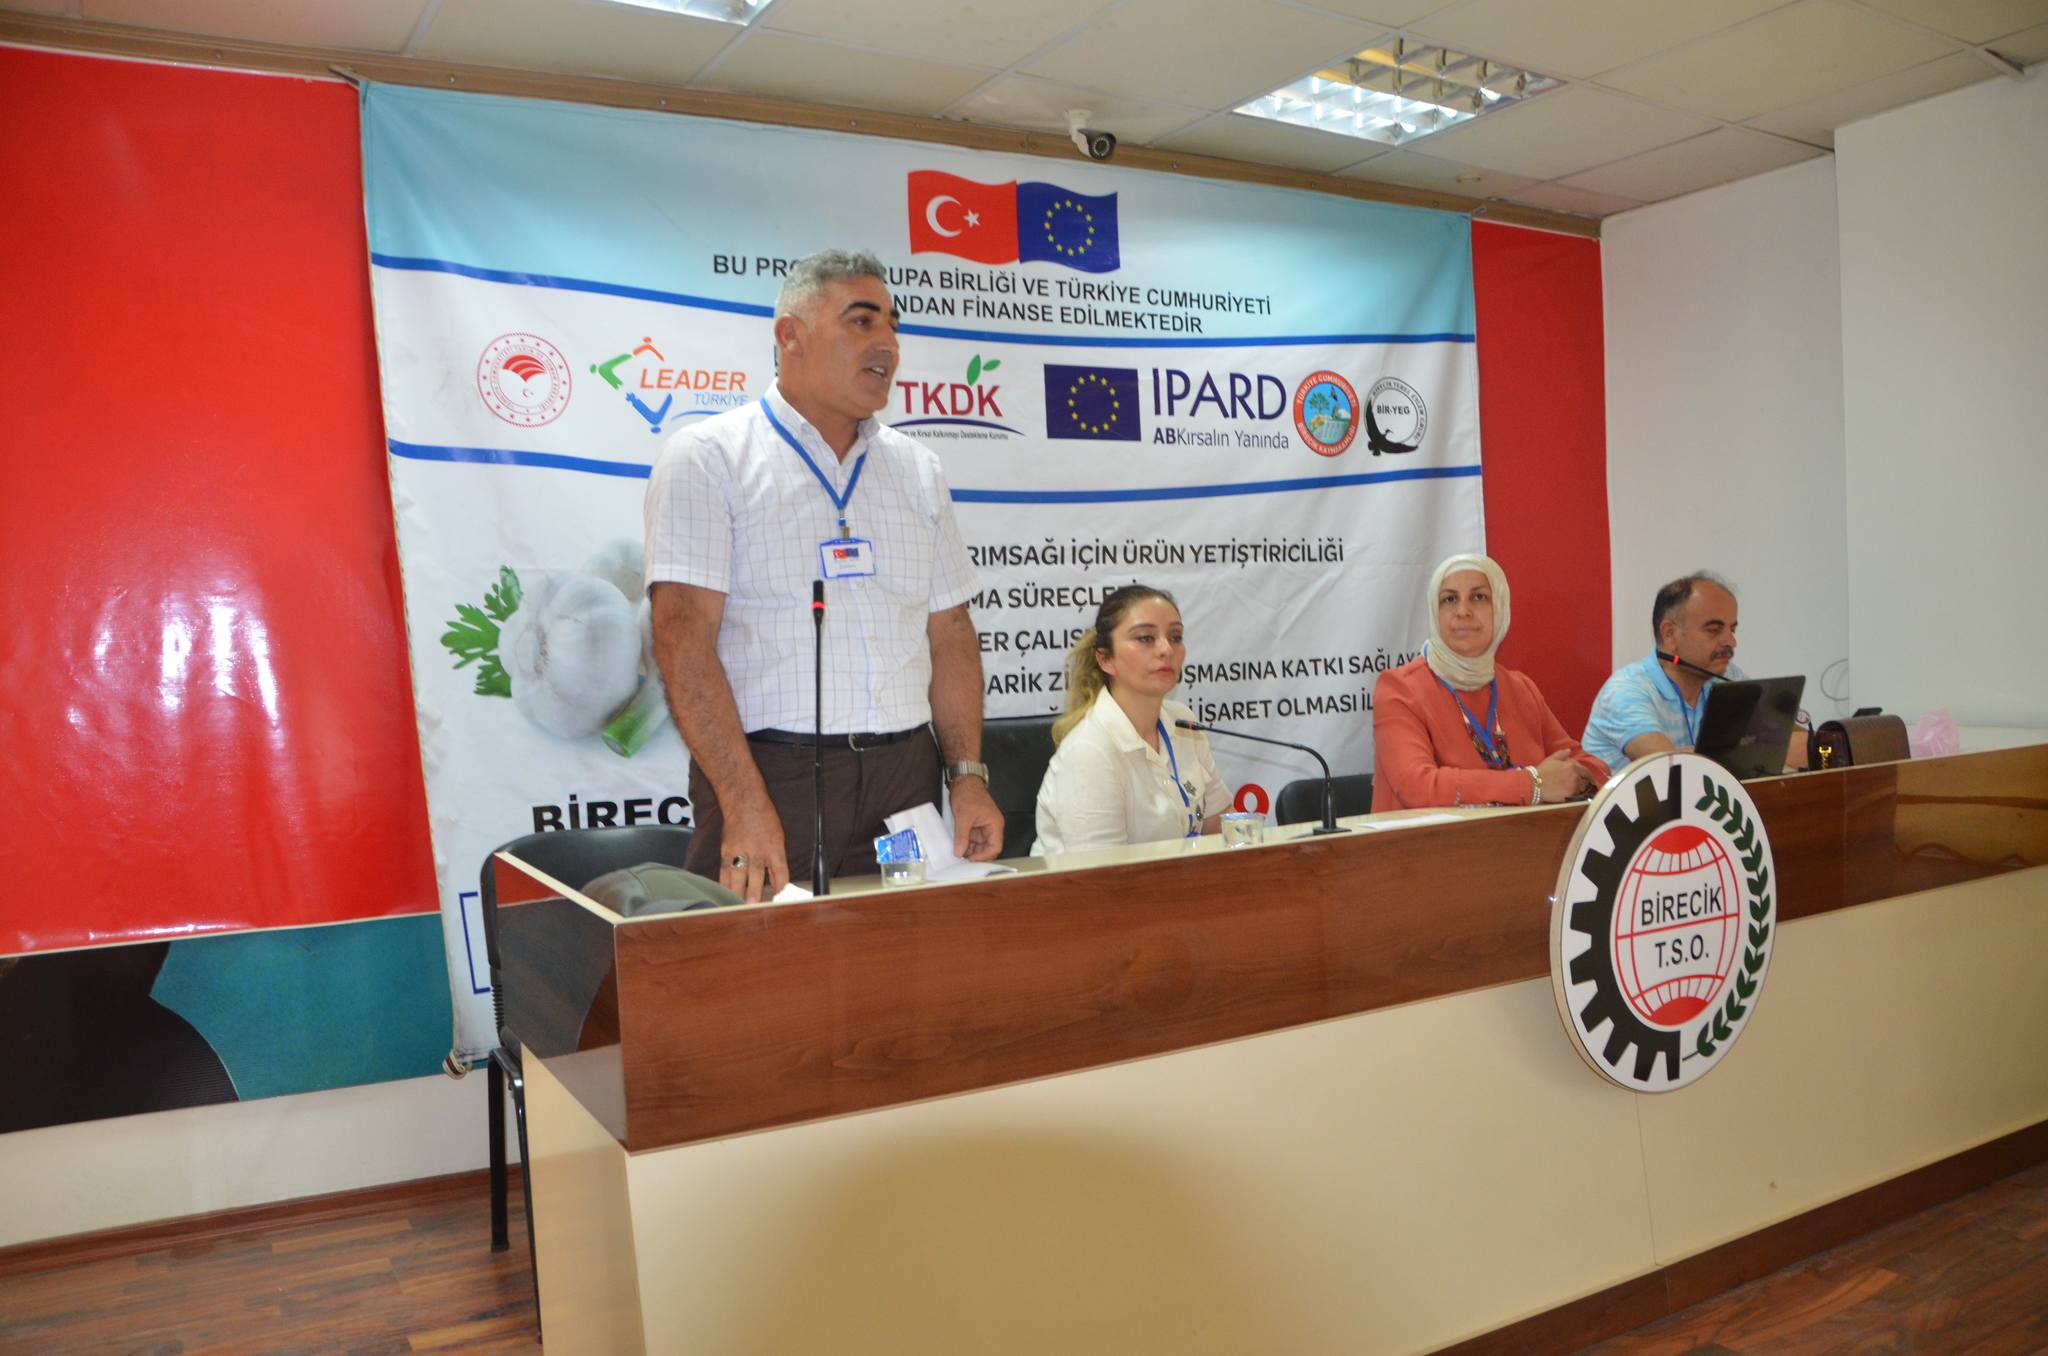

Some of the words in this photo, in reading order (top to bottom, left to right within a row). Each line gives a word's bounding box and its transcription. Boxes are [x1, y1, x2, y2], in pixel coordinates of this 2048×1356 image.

[713, 254, 747, 275] BU
[939, 268, 1016, 294] BİRLİĞİ
[1022, 278, 1049, 296] VE
[1055, 278, 1141, 304] TÜRKİYE
[1147, 288, 1272, 316] CUMHURİYETİ
[963, 296, 1053, 323] FİNANSE
[1060, 304, 1203, 334] EDİLMEKTEDİR
[640, 368, 747, 392] LEADER
[1152, 367, 1287, 421] IPARD
[694, 391, 749, 407] TÜRKİYE
[896, 380, 1003, 418] TKDK
[1153, 427, 1230, 449] ABKırsalın
[1234, 430, 1289, 450] Yanında
[1072, 538, 1117, 571] İÇİN
[1123, 539, 1184, 565] ÜRÜN
[1190, 537, 1344, 569] YETİŞTİRİCİLİĞİ
[978, 631, 1009, 652] ER
[1282, 657, 1343, 678] KATKI
[1198, 698, 1272, 728] İŞARET
[1277, 694, 1357, 716] OLMASI
[532, 794, 692, 833] BİREC
[1641, 883, 1722, 926] BİRECİK
[1655, 934, 1709, 968] T.S.O.
